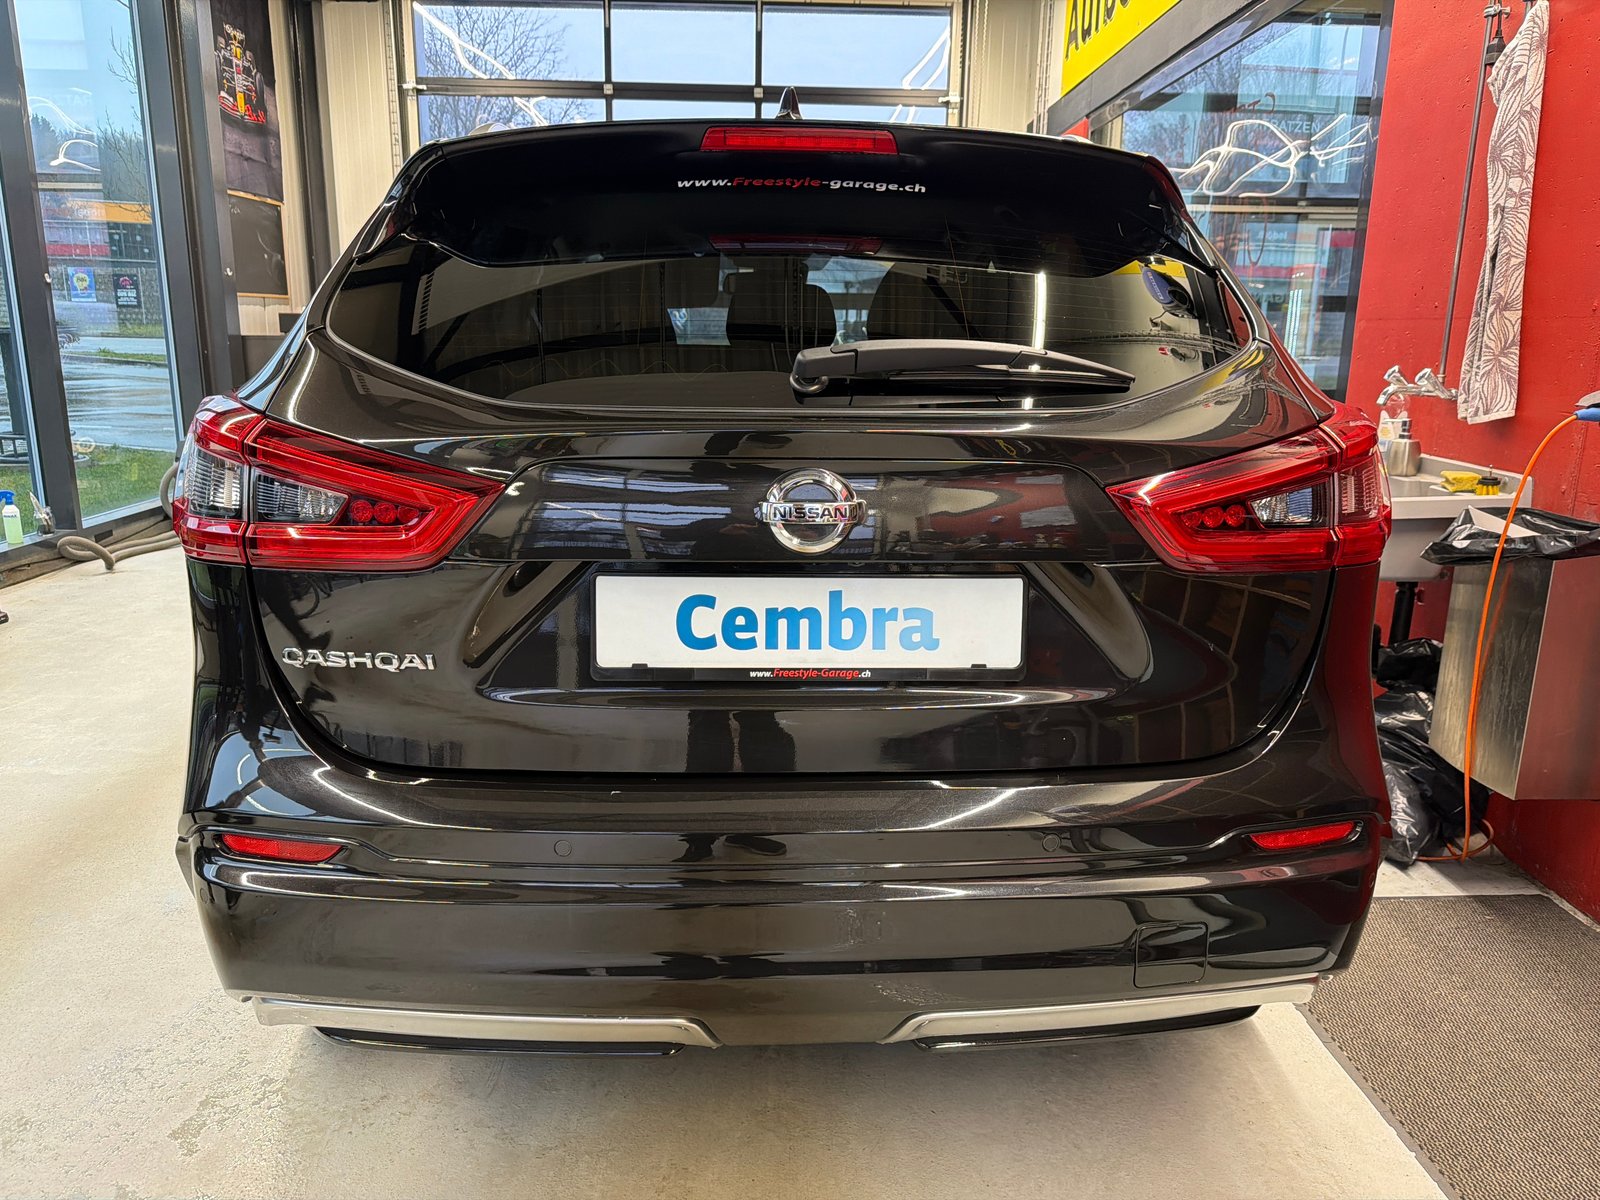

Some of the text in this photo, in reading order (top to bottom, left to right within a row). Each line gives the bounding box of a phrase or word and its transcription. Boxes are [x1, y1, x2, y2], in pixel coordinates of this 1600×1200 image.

[677, 177, 926, 193] www.Freestyle-garage.ch
[773, 507, 848, 519] NISSAN
[675, 589, 940, 651] Cembra
[282, 647, 435, 673] QASHQAI
[749, 668, 871, 679] www.Freestyle-Garage.ch
